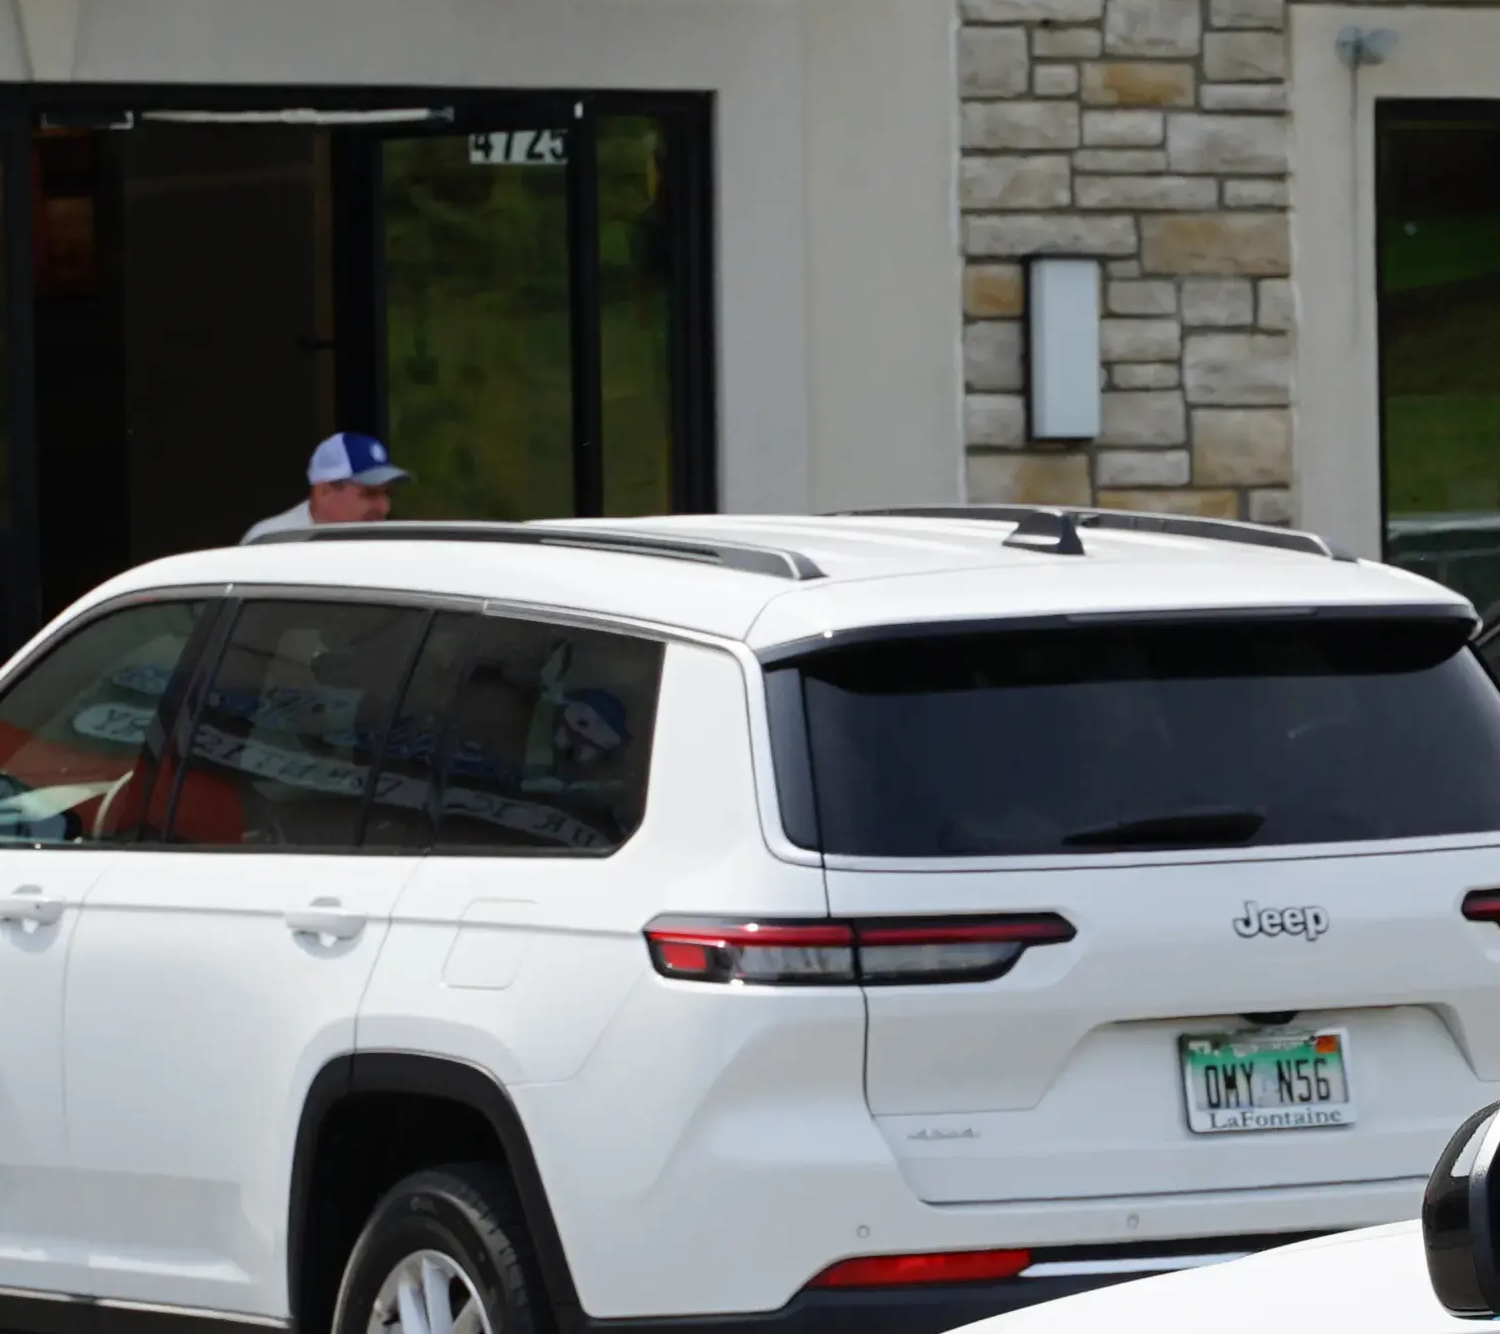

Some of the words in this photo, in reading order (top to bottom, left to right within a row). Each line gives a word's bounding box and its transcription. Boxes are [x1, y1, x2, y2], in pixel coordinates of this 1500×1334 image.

[1232, 899, 1330, 942] Jeep
[1276, 1057, 1332, 1103] N56
[1209, 1107, 1343, 1129] LaFontaine
